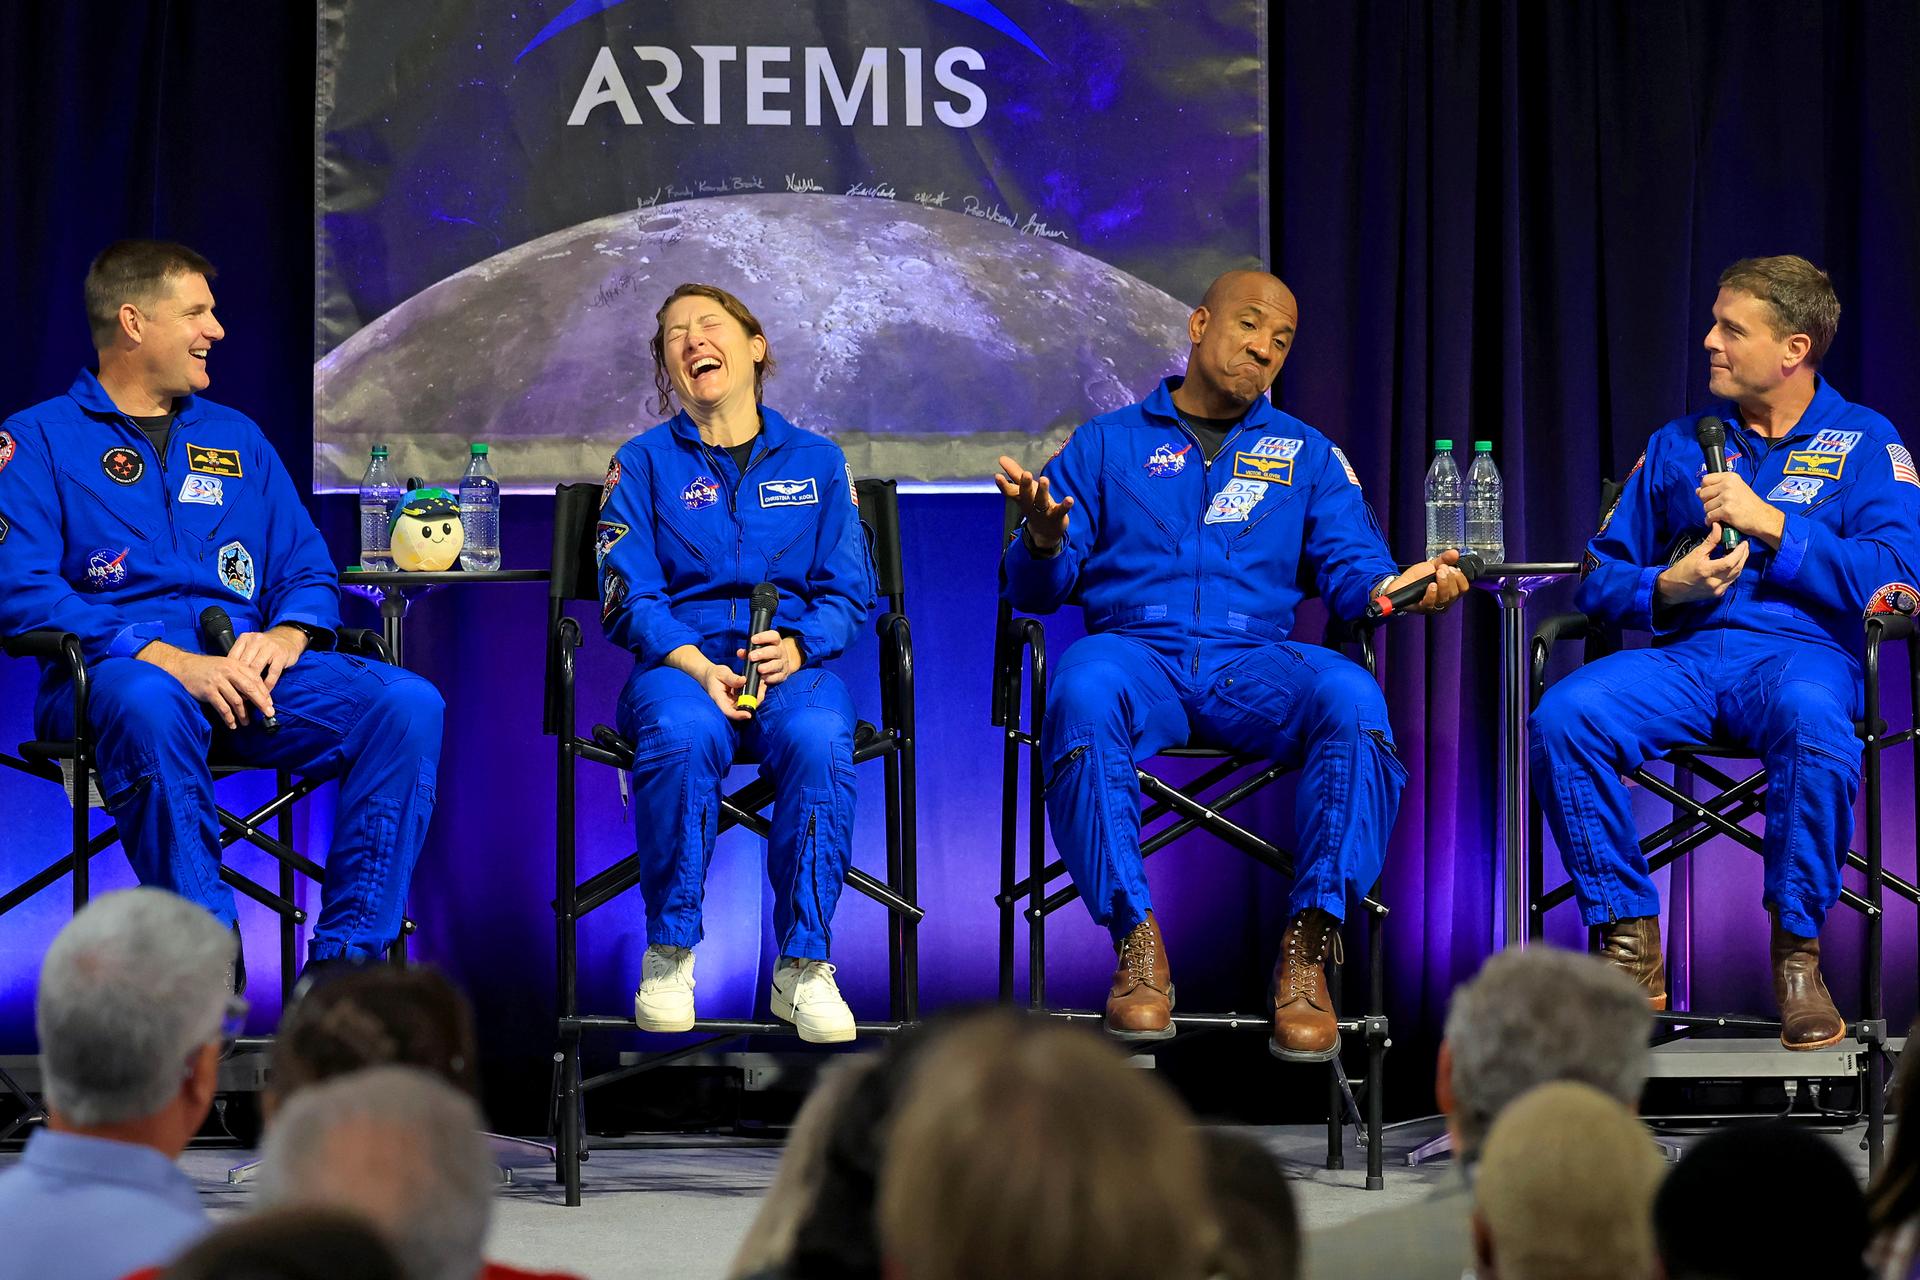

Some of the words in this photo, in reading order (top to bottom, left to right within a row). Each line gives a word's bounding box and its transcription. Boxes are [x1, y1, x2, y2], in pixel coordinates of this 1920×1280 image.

[566, 45, 988, 129] ARTEMIS
[1150, 454, 1186, 464] NASA
[685, 488, 718, 500] NASA
[764, 495, 791, 503] CHRISTINA
[88, 562, 125, 577] NASA
